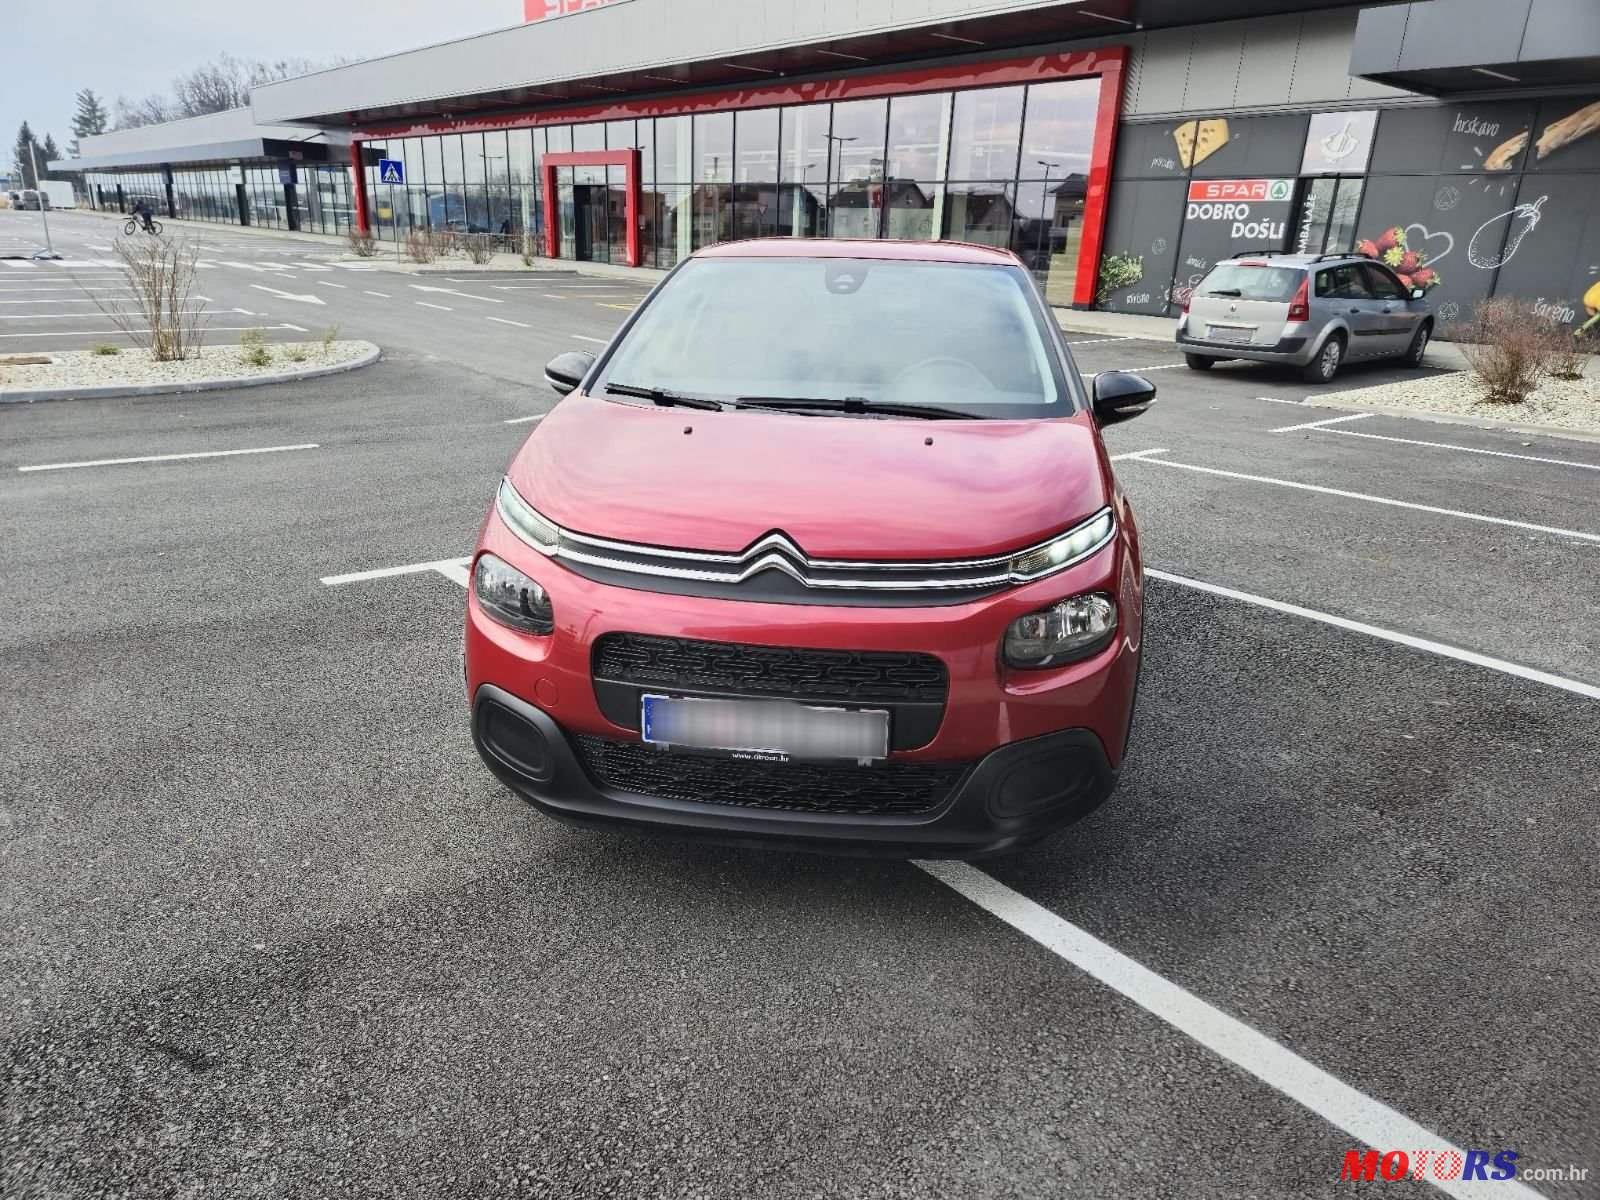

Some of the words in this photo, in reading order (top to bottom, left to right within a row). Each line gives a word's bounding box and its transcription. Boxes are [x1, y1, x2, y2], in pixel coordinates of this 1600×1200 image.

[1453, 113, 1500, 137] hrskavo
[1206, 184, 1266, 197] SPAR
[1187, 203, 1250, 220] DOBRO
[1231, 217, 1285, 239] DOŠLI
[732, 753, 789, 762] www.citroen.hr
